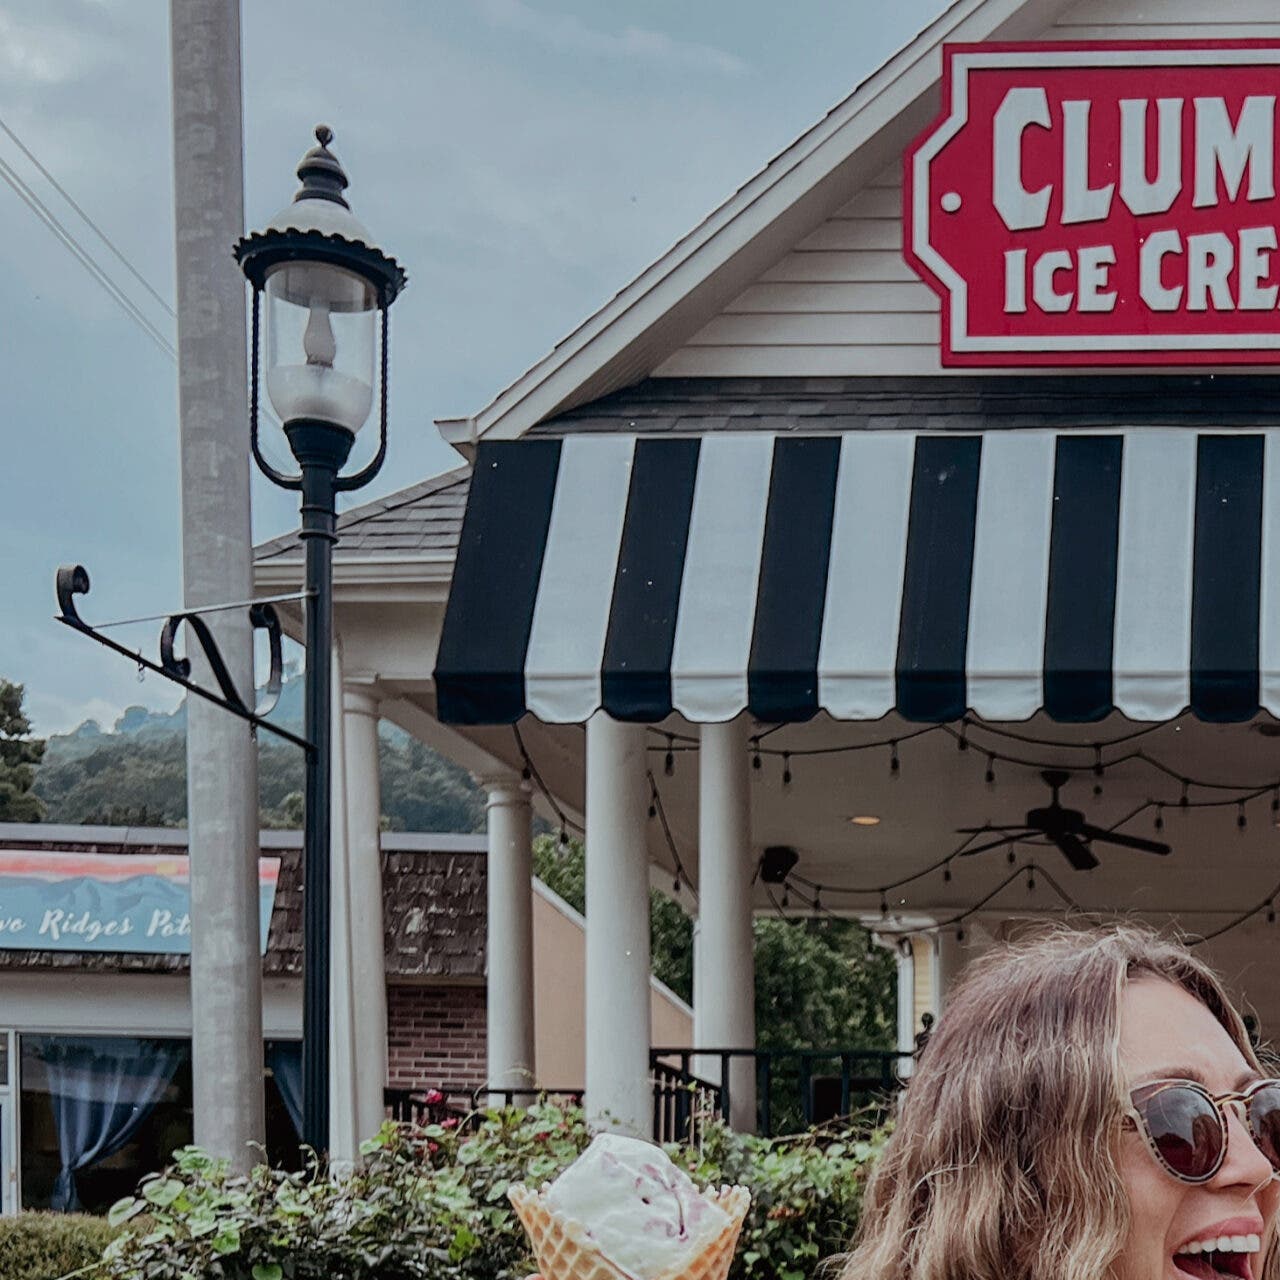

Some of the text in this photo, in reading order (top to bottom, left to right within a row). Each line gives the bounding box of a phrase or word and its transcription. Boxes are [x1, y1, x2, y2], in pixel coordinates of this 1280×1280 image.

[1003, 245, 1118, 313] ICE
[39, 908, 134, 942] Ridges
[147, 908, 191, 937] Pot
